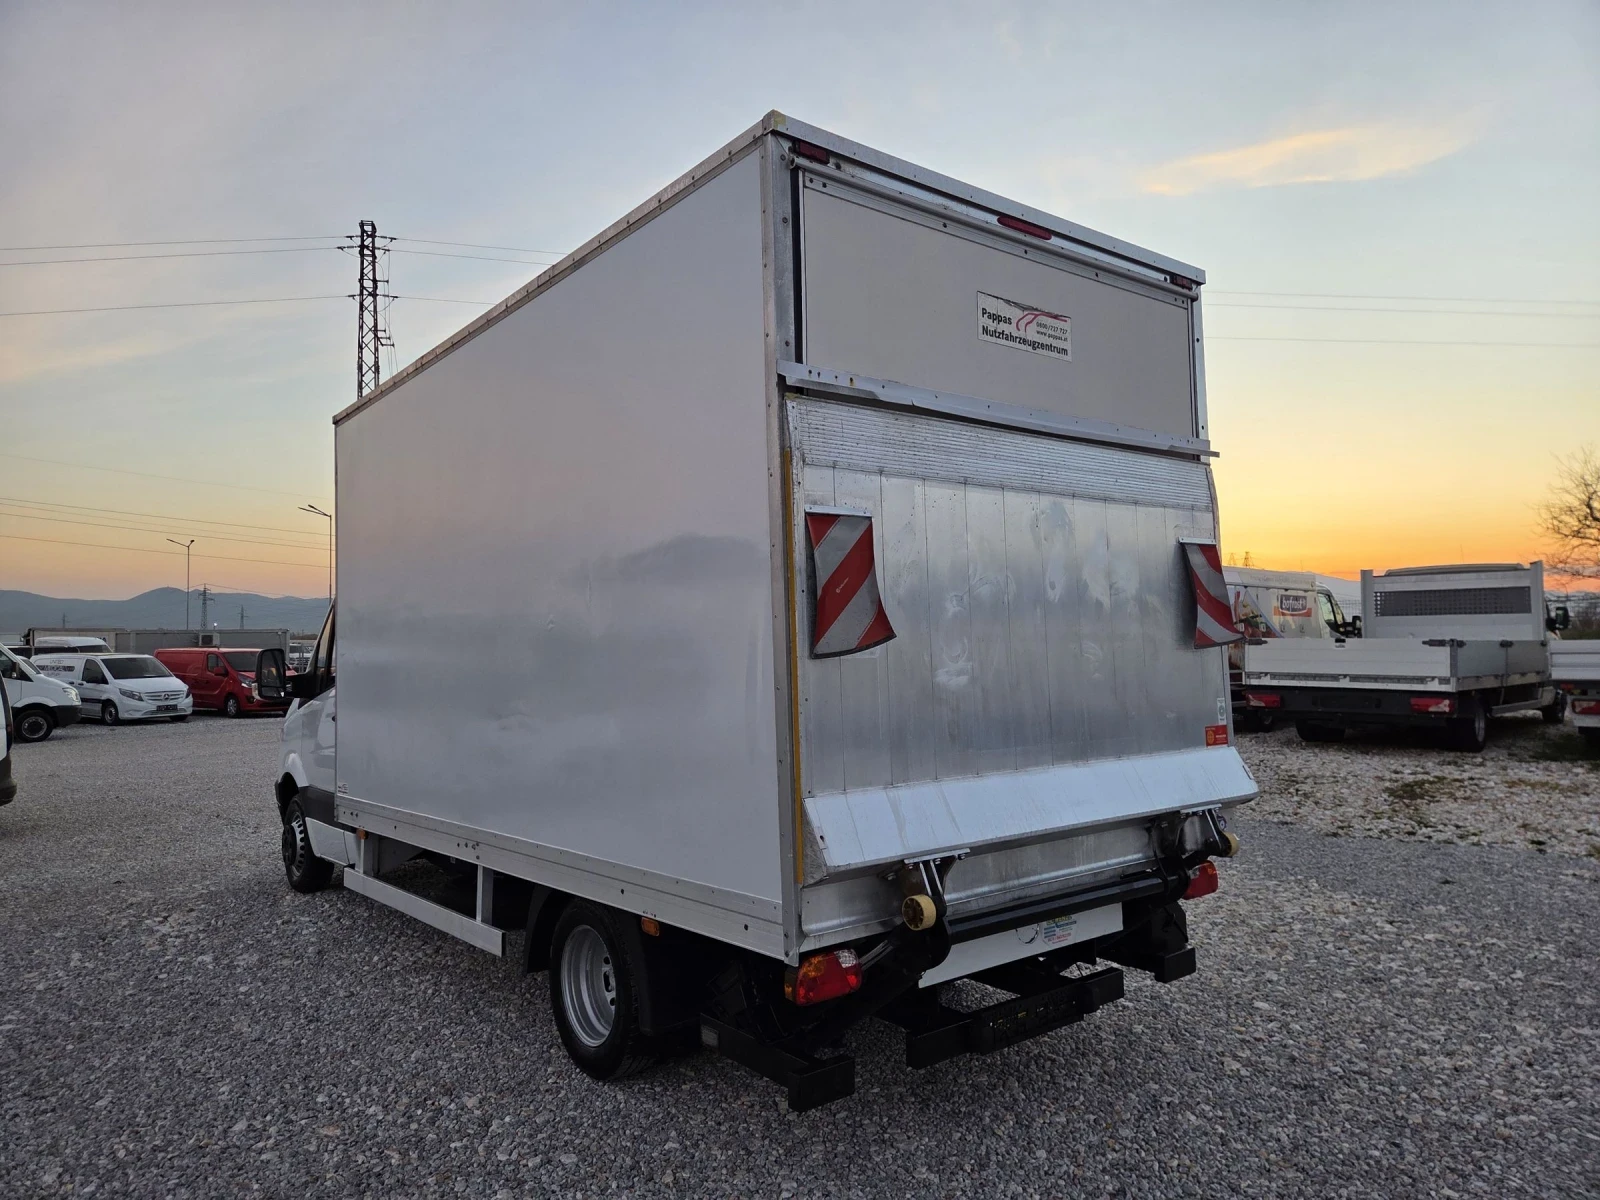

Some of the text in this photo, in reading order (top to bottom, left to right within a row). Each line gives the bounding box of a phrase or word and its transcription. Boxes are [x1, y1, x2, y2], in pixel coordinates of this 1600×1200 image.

[981, 307, 1013, 325] Pappas
[982, 325, 1069, 356] Nutzfahrzeugzentrum
[1036, 329, 1068, 342] www.pappas.at
